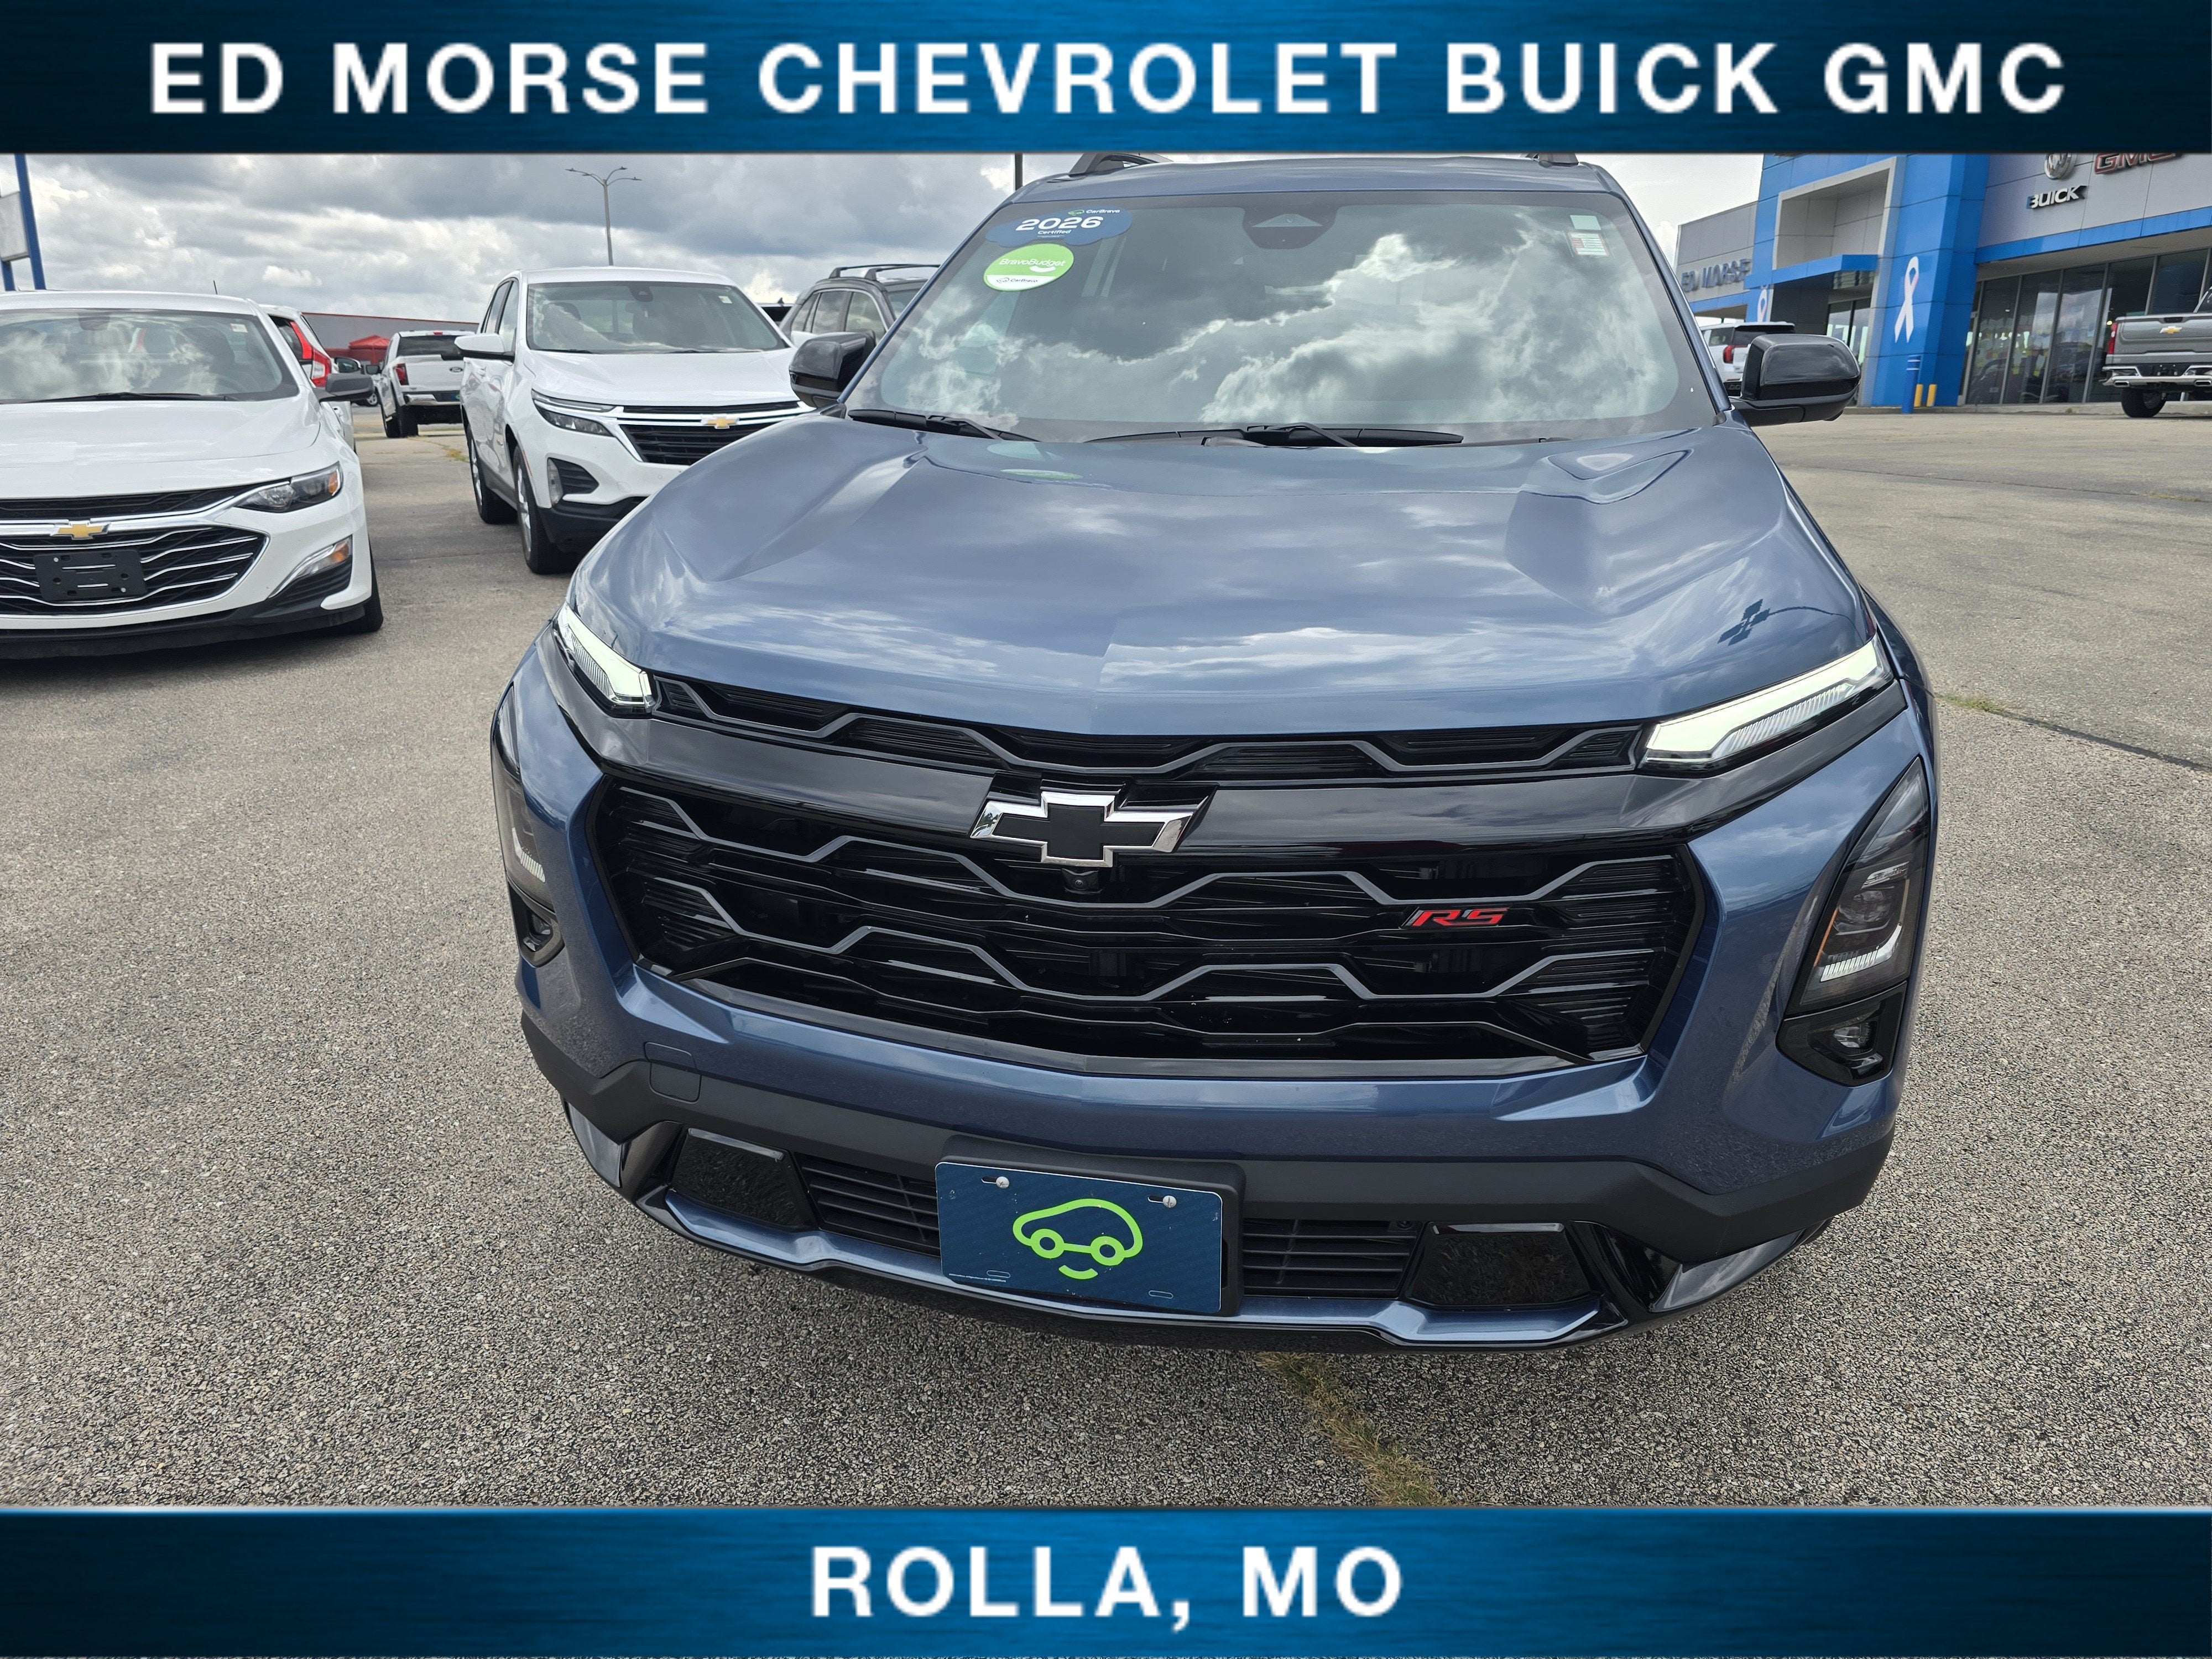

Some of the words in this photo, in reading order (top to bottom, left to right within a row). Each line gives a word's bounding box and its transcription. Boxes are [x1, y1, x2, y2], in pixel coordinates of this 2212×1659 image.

[2026, 185, 2086, 210] BUICK
[1015, 216, 1104, 231] 2026
[999, 258, 1066, 267] BravoBudget
[1405, 907, 1510, 926] RS
